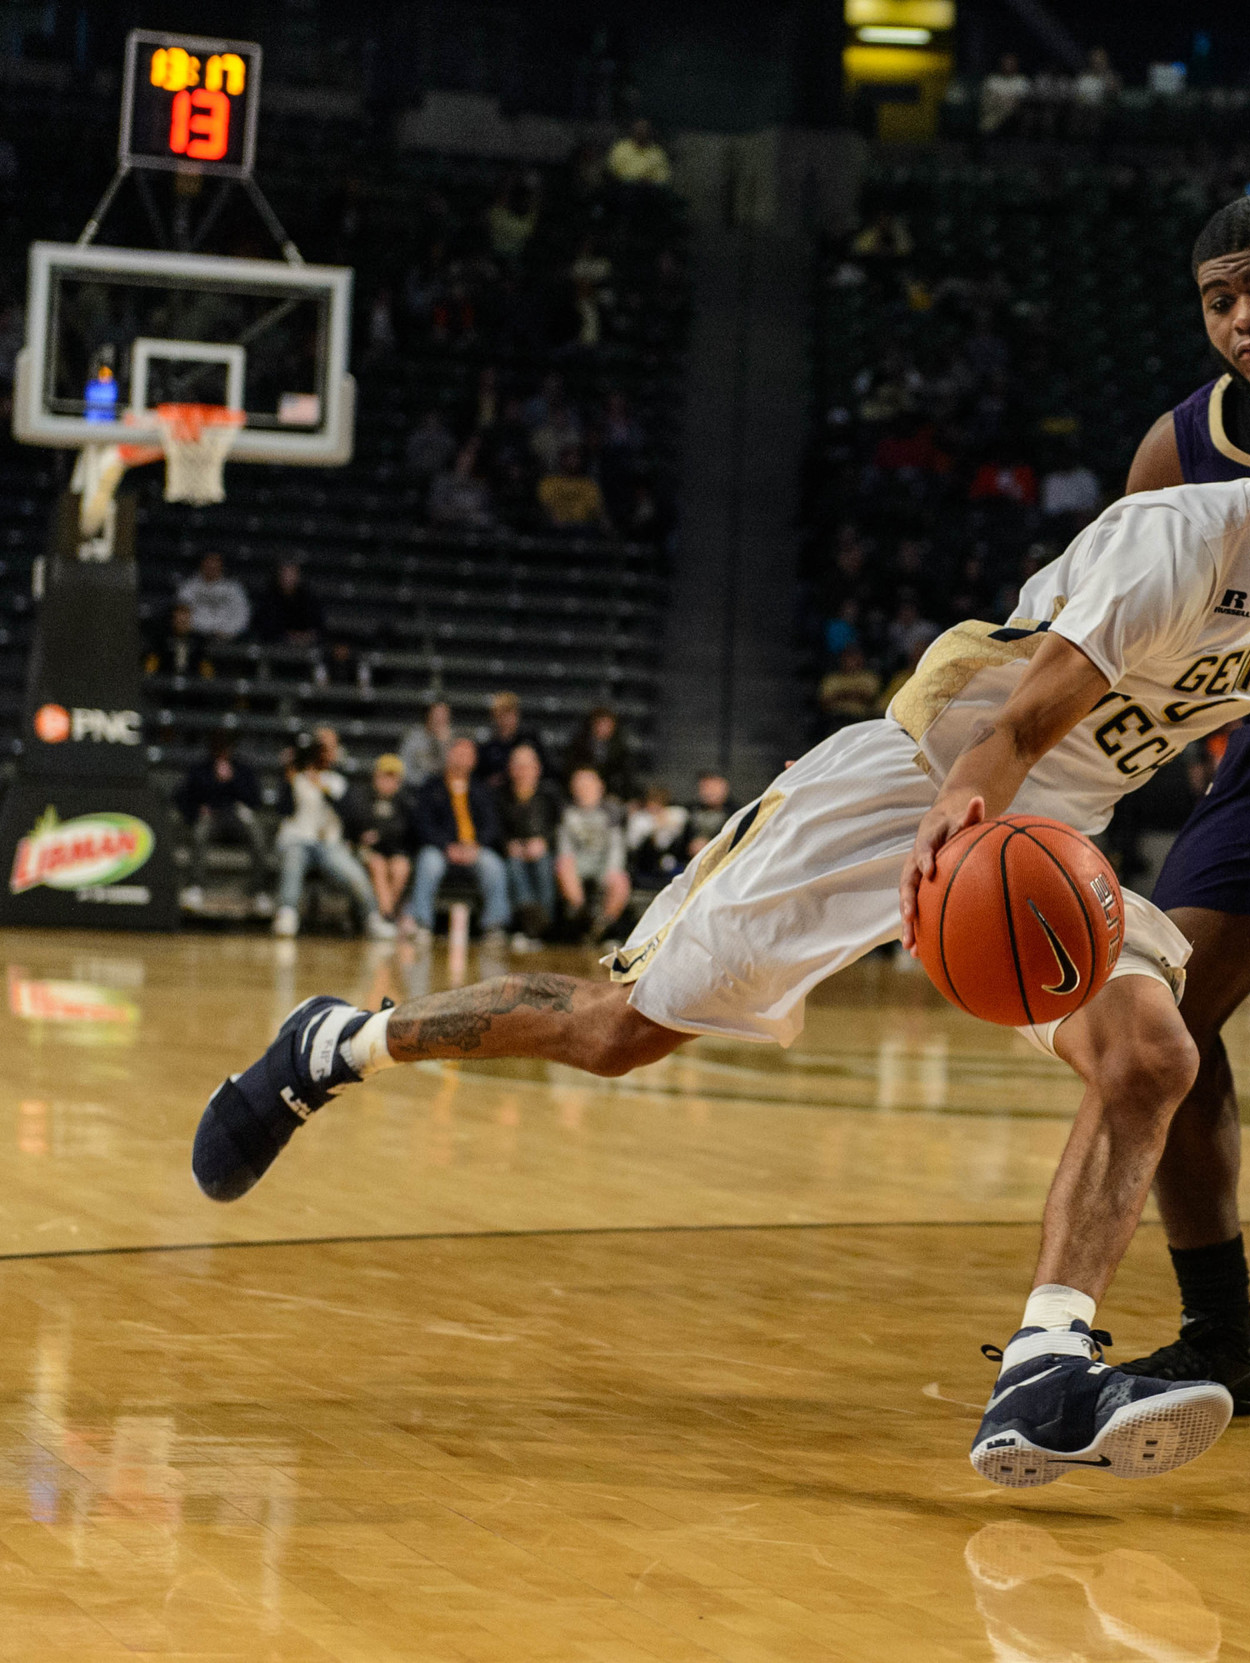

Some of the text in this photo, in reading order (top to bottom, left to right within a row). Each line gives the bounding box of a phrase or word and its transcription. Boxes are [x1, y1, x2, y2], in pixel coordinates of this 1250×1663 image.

[169, 88, 230, 160] 13
[1214, 606, 1250, 618] RUSSELL
[71, 707, 143, 746] PNC
